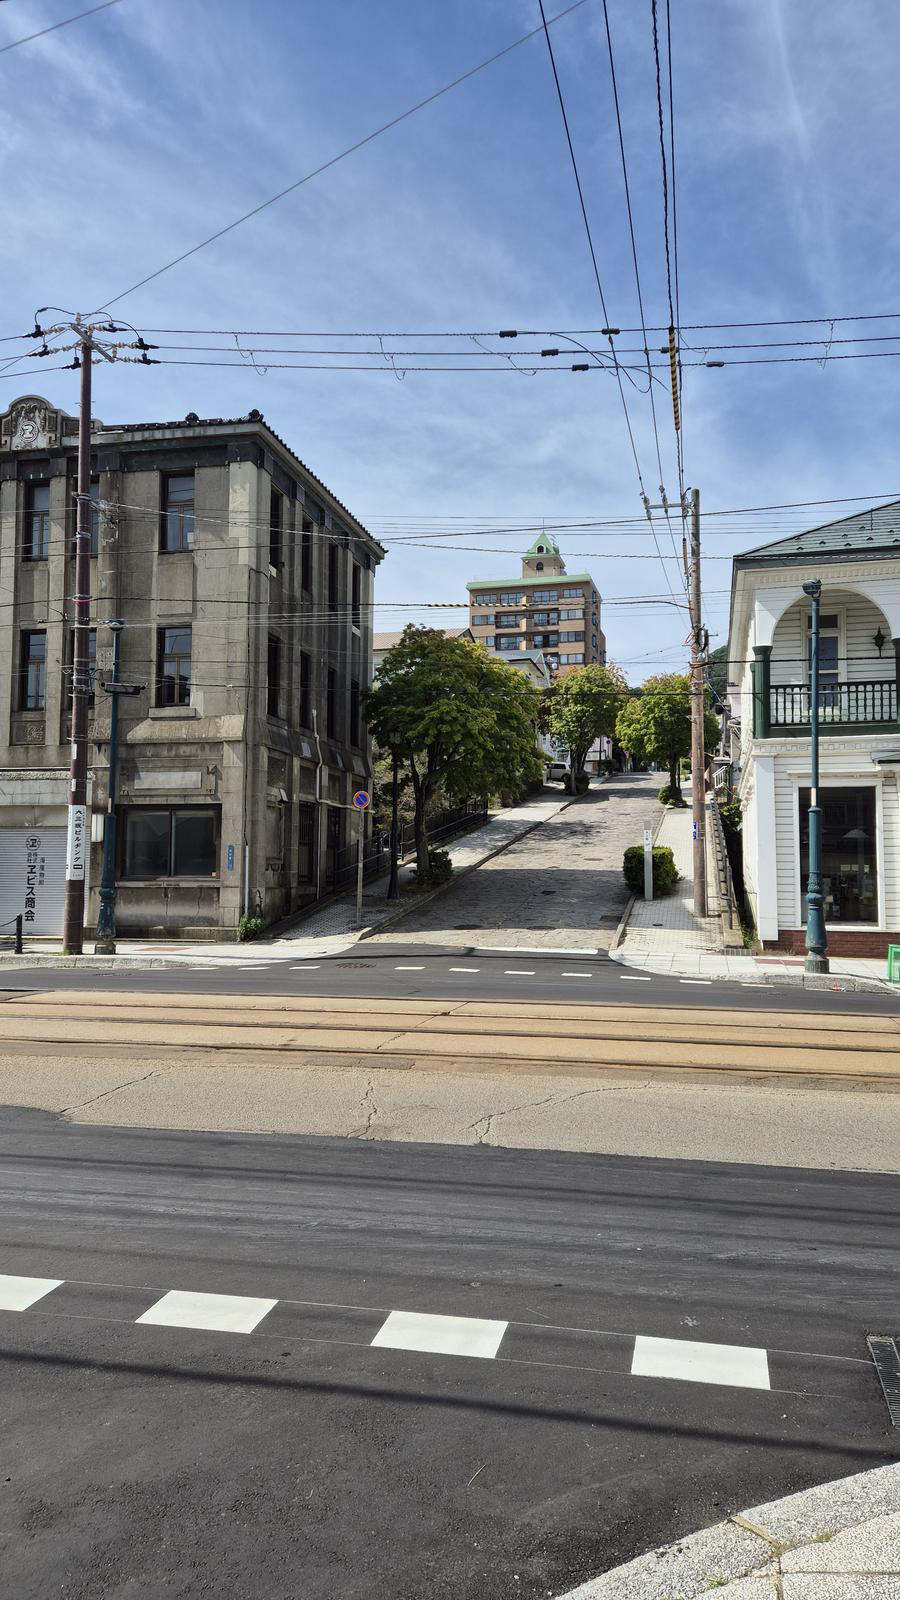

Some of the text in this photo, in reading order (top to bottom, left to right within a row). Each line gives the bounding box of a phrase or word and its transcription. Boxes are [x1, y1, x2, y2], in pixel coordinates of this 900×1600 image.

[24, 865, 37, 922] ヱビス商会
